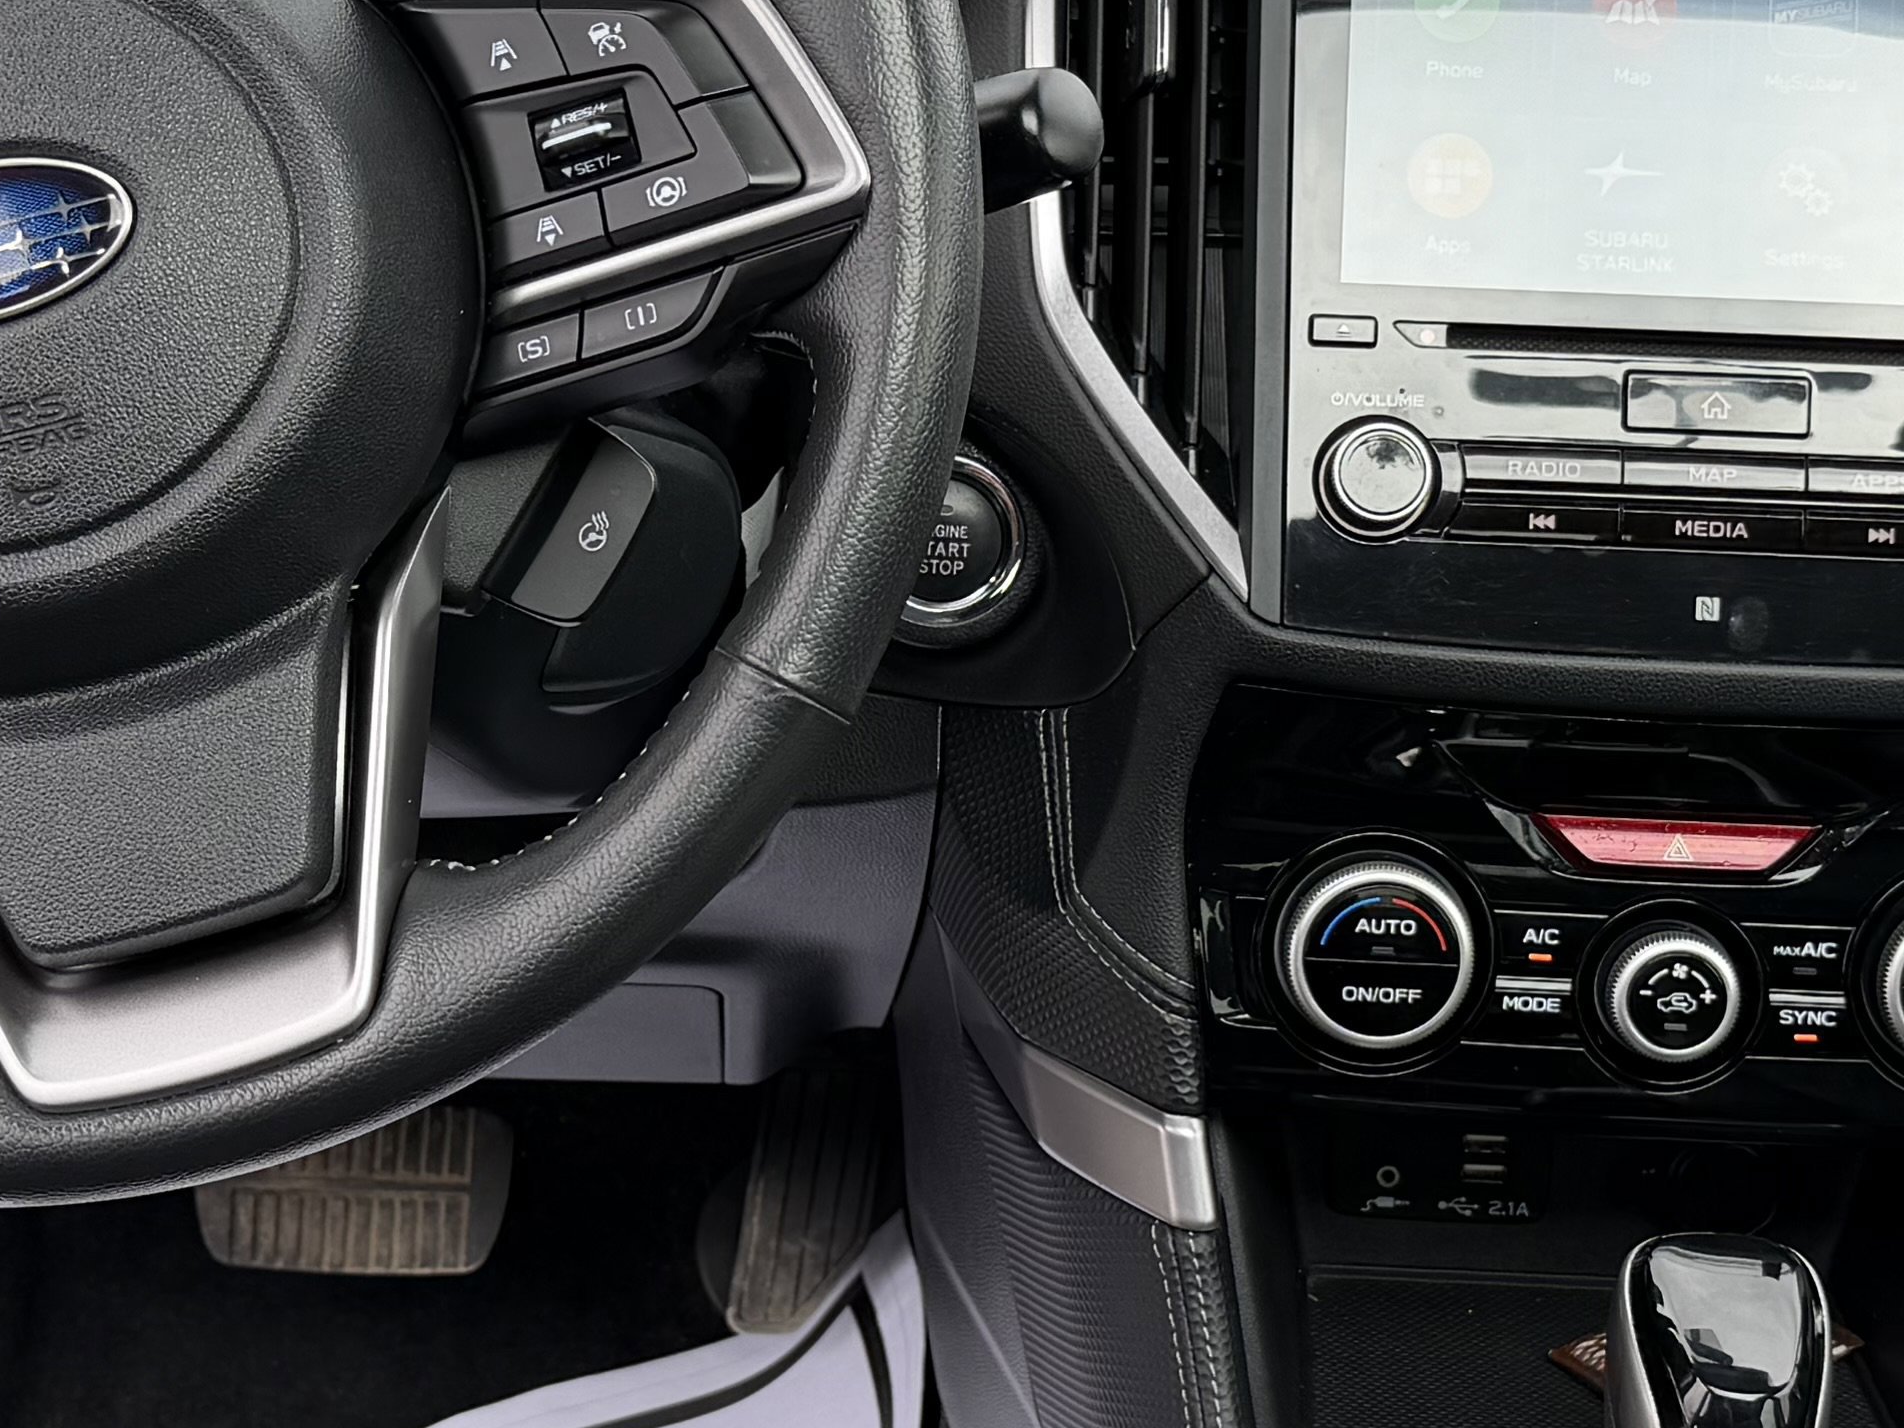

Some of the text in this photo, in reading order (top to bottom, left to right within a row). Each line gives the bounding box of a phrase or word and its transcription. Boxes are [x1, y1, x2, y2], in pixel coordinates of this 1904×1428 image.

[1425, 60, 1484, 79] Phone
[1614, 67, 1652, 86] Map
[1425, 235, 1471, 255] Apps
[1584, 229, 1669, 249] SUBARU
[1576, 254, 1675, 273] STARLINK
[1508, 460, 1581, 478] RADIO
[1689, 467, 1738, 483] MAP
[932, 524, 969, 539] GINE
[1675, 520, 1749, 539] MEDIA
[927, 541, 971, 558] TART
[919, 559, 965, 576] STOP
[1355, 918, 1417, 936] AUTO
[1523, 928, 1561, 945] A/C
[1341, 986, 1423, 1004] ON/OFF
[1502, 995, 1562, 1013] MODE
[1779, 1009, 1837, 1027] SYNC
[1488, 1201, 1529, 1217] 2.1A
